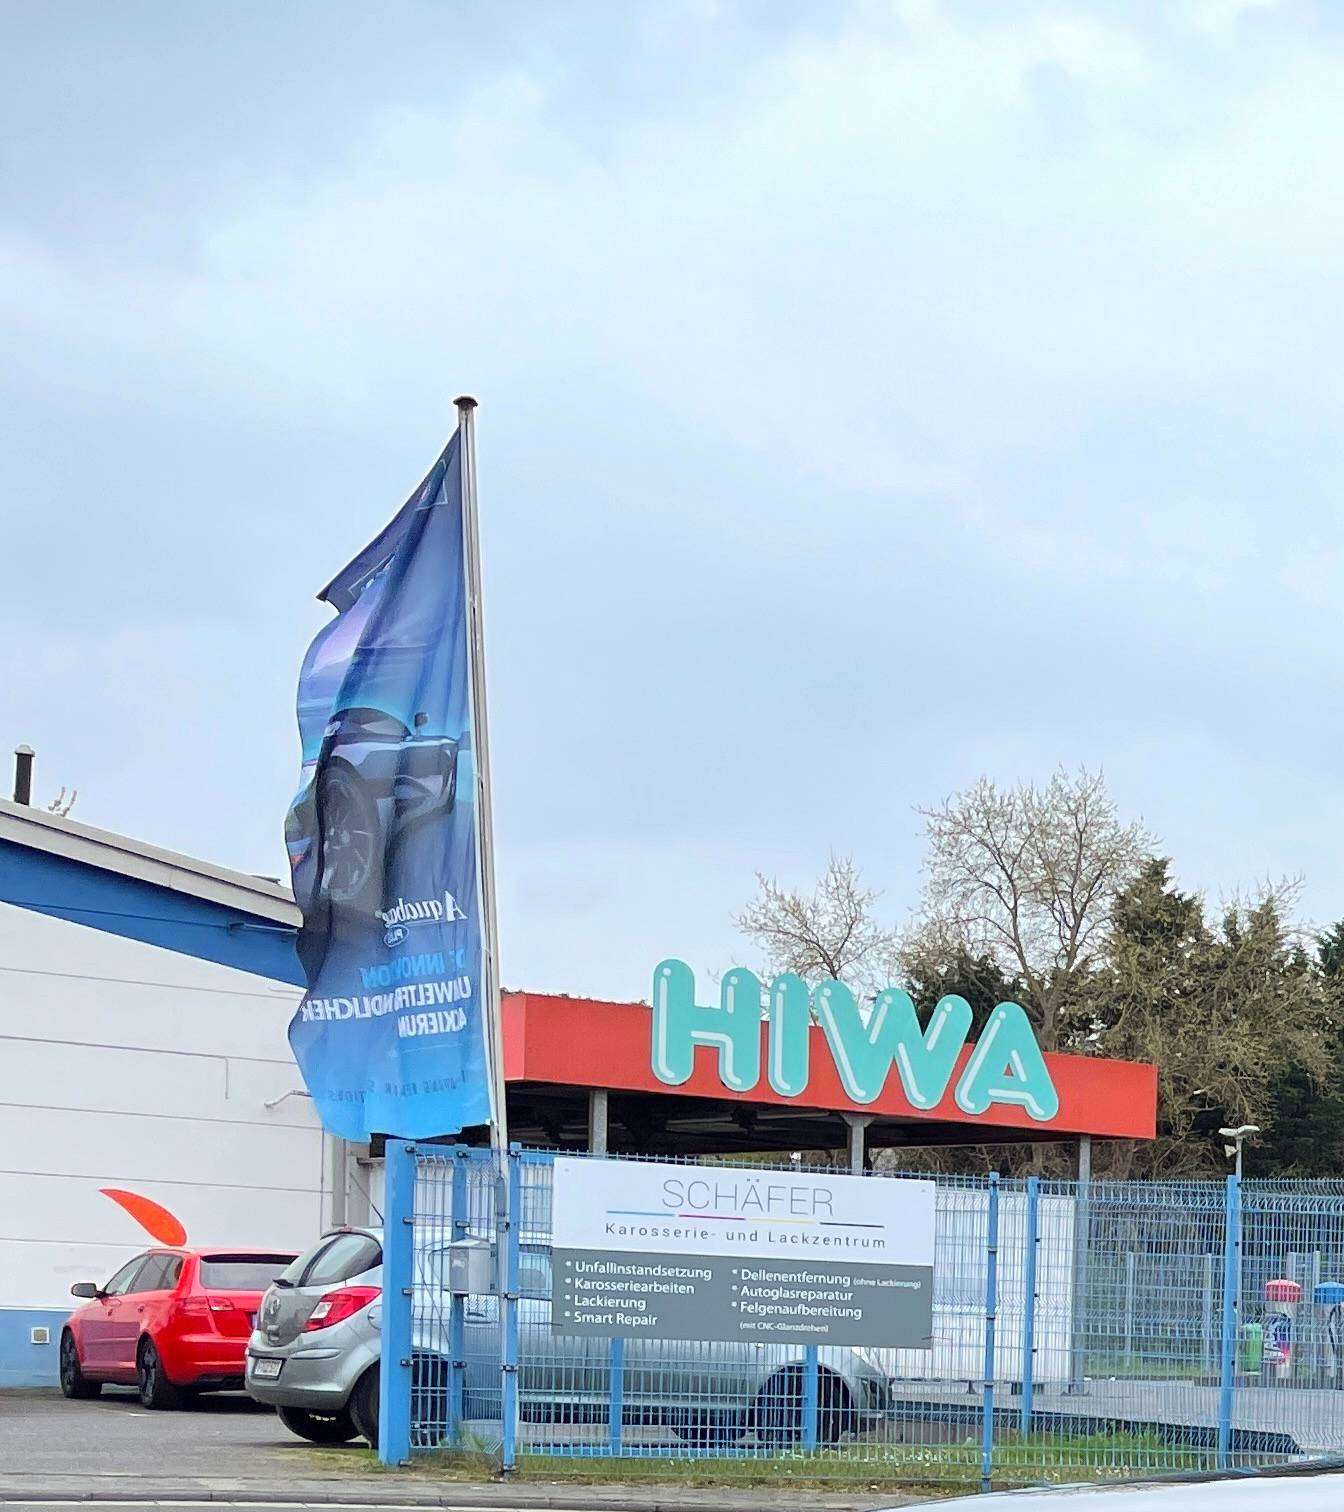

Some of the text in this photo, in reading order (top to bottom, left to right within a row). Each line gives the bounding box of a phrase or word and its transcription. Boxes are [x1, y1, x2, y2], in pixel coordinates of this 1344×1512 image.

[651, 959, 1059, 1122] HIWA
[662, 1178, 833, 1216] SCHÄFER
[605, 1222, 886, 1249] Karosserie- und Lackzentrum
[575, 1261, 712, 1281] Unfallinstandsetzung
[741, 1268, 851, 1288] Dellenentfernung
[574, 1277, 695, 1295] Karosseriearbeiten
[740, 1285, 854, 1302] Autoglasreparatur
[574, 1294, 647, 1311] Lackierung
[740, 1301, 863, 1321] Felgenaufbereitung
[574, 1310, 658, 1328] Smart Repair
